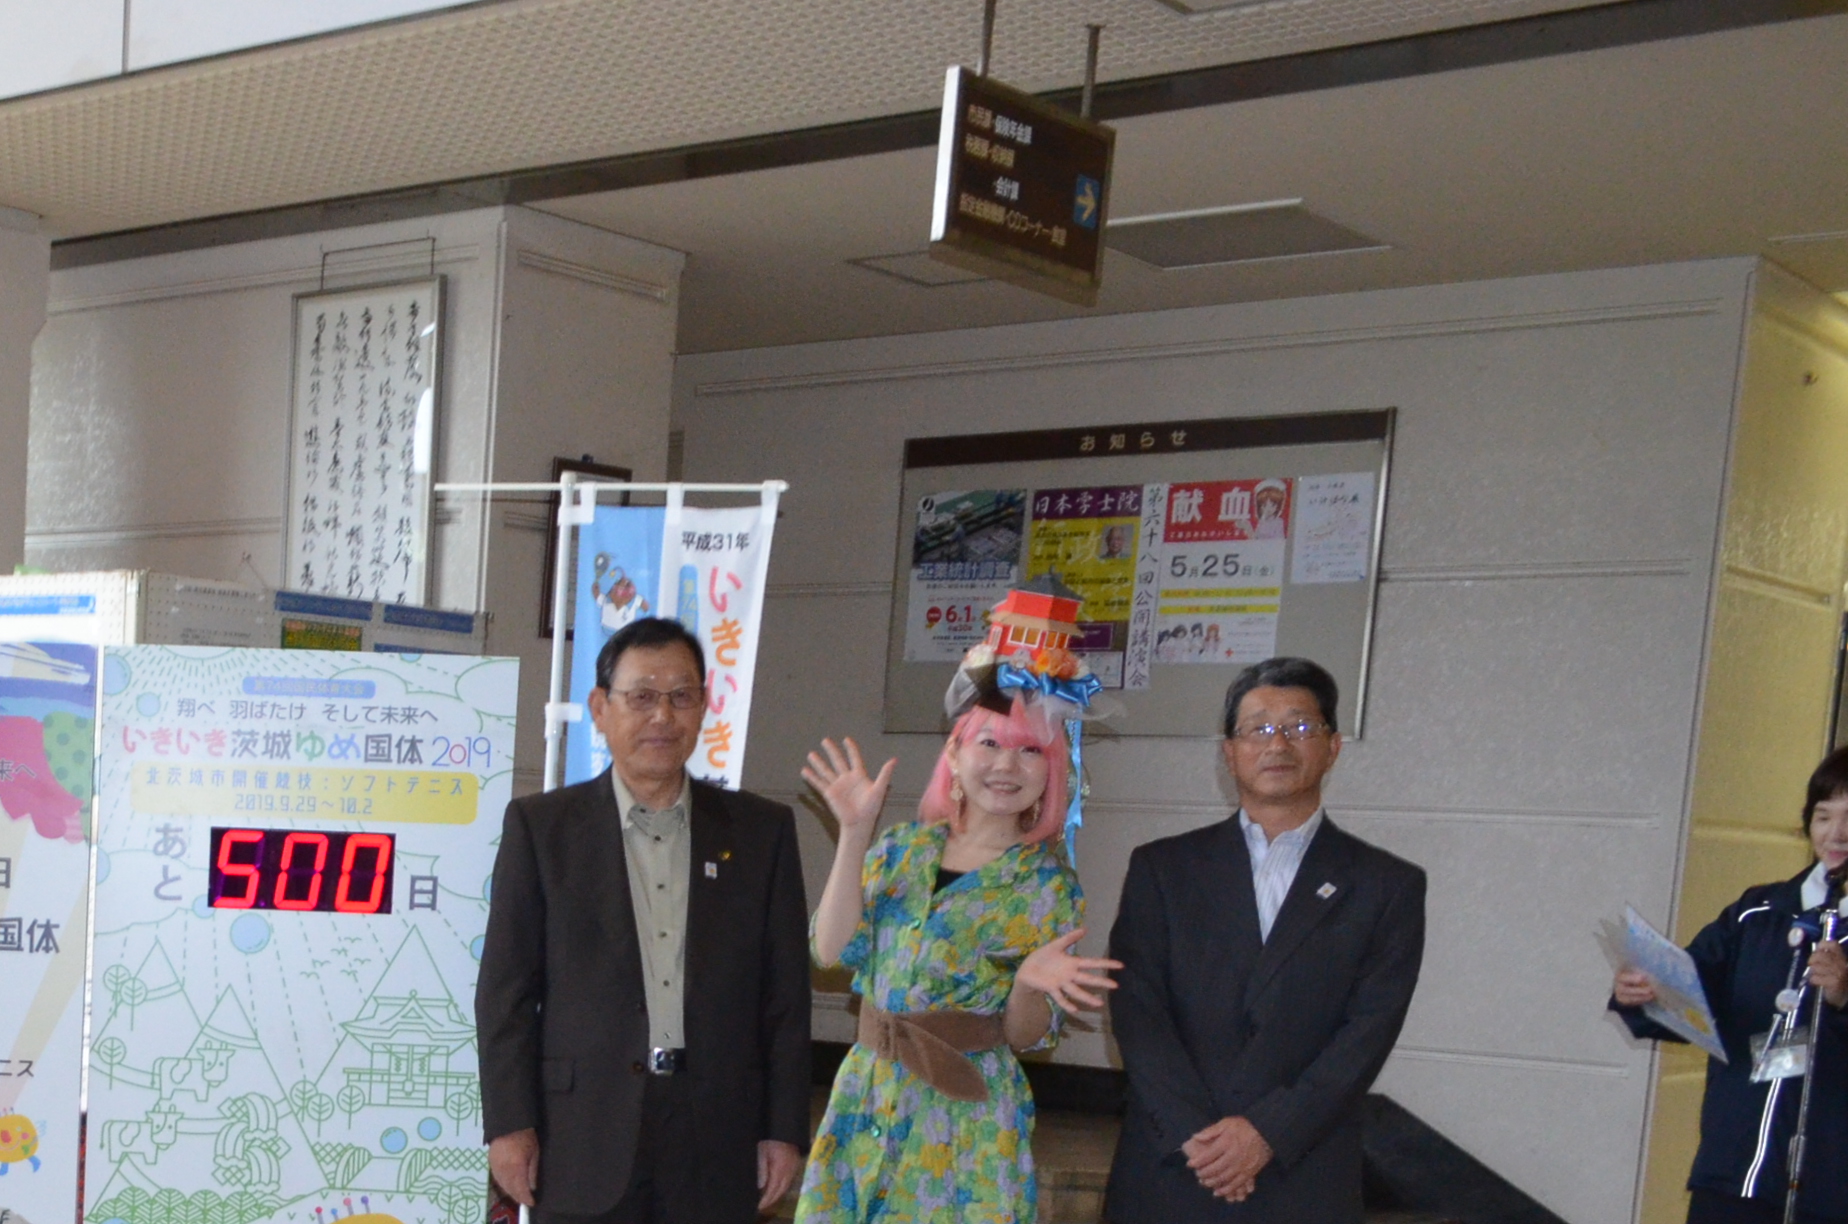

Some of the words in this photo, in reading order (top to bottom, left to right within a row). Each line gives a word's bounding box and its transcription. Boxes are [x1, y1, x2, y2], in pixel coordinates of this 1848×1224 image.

[1079, 430, 1189, 452] お知らせ
[1171, 486, 1251, 524] 献血
[681, 530, 750, 551] 平成31年
[178, 698, 215, 718] 翔べ
[230, 700, 307, 720] 羽ばたけ
[322, 703, 439, 725] そして未来へ
[122, 726, 423, 765] いきいき茨城ゆめ国体
[431, 735, 492, 768] 2019
[153, 822, 189, 902] あと
[214, 830, 392, 912] 500
[408, 875, 440, 912] 日
